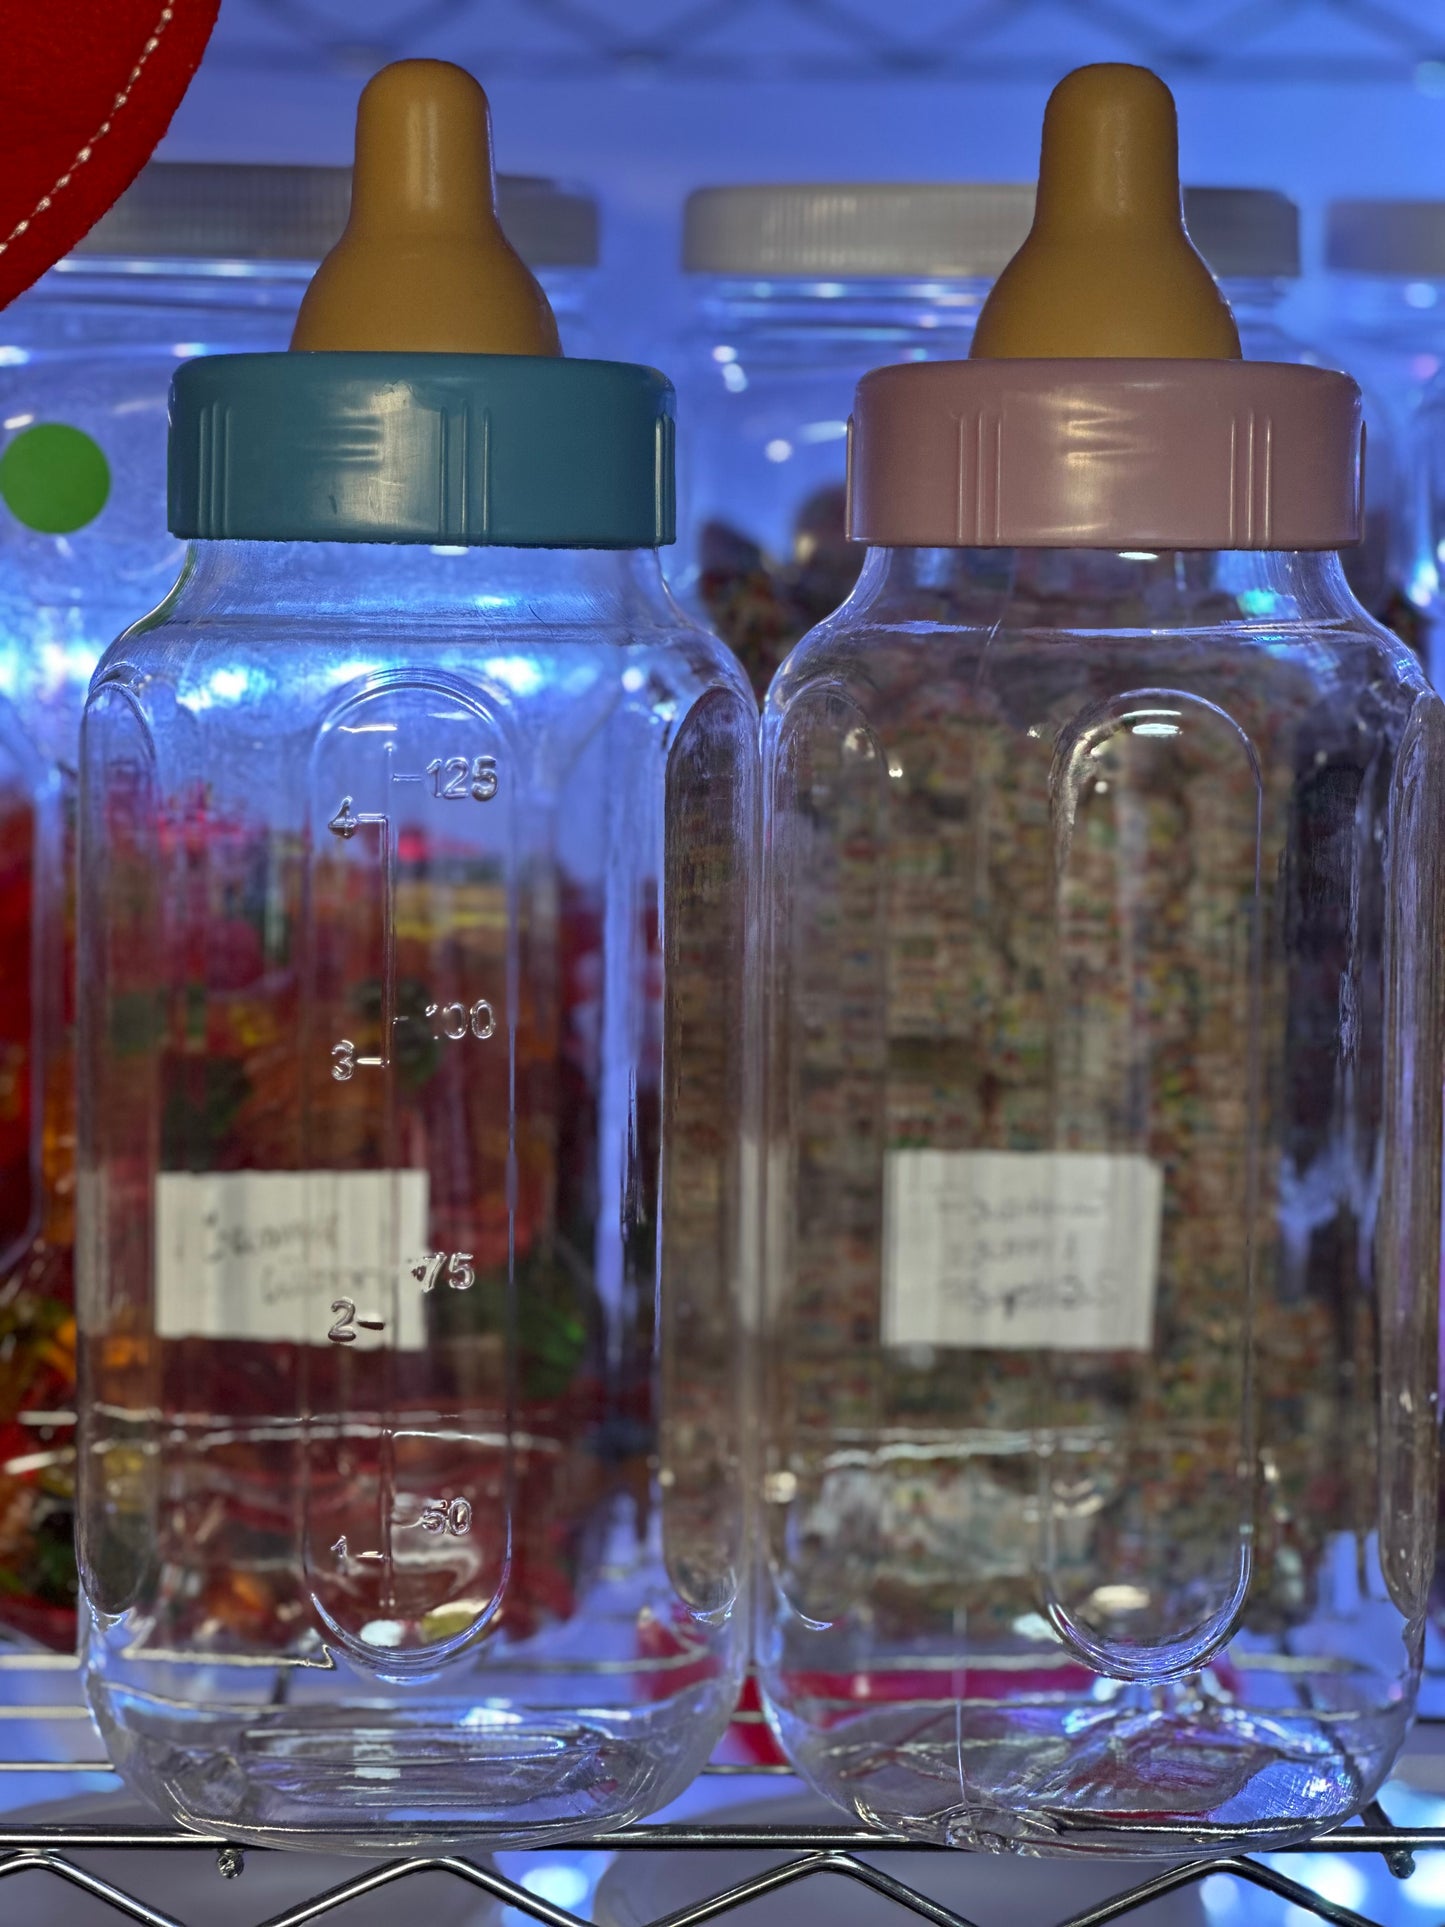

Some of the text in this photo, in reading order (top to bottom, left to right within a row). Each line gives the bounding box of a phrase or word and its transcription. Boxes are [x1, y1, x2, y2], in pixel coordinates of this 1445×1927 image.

[426, 755, 498, 801] 125
[328, 796, 357, 839] 4
[331, 1039, 354, 1081] 3
[422, 1252, 475, 1293] 75
[328, 1297, 357, 1343] 2
[422, 1496, 472, 1535] 50
